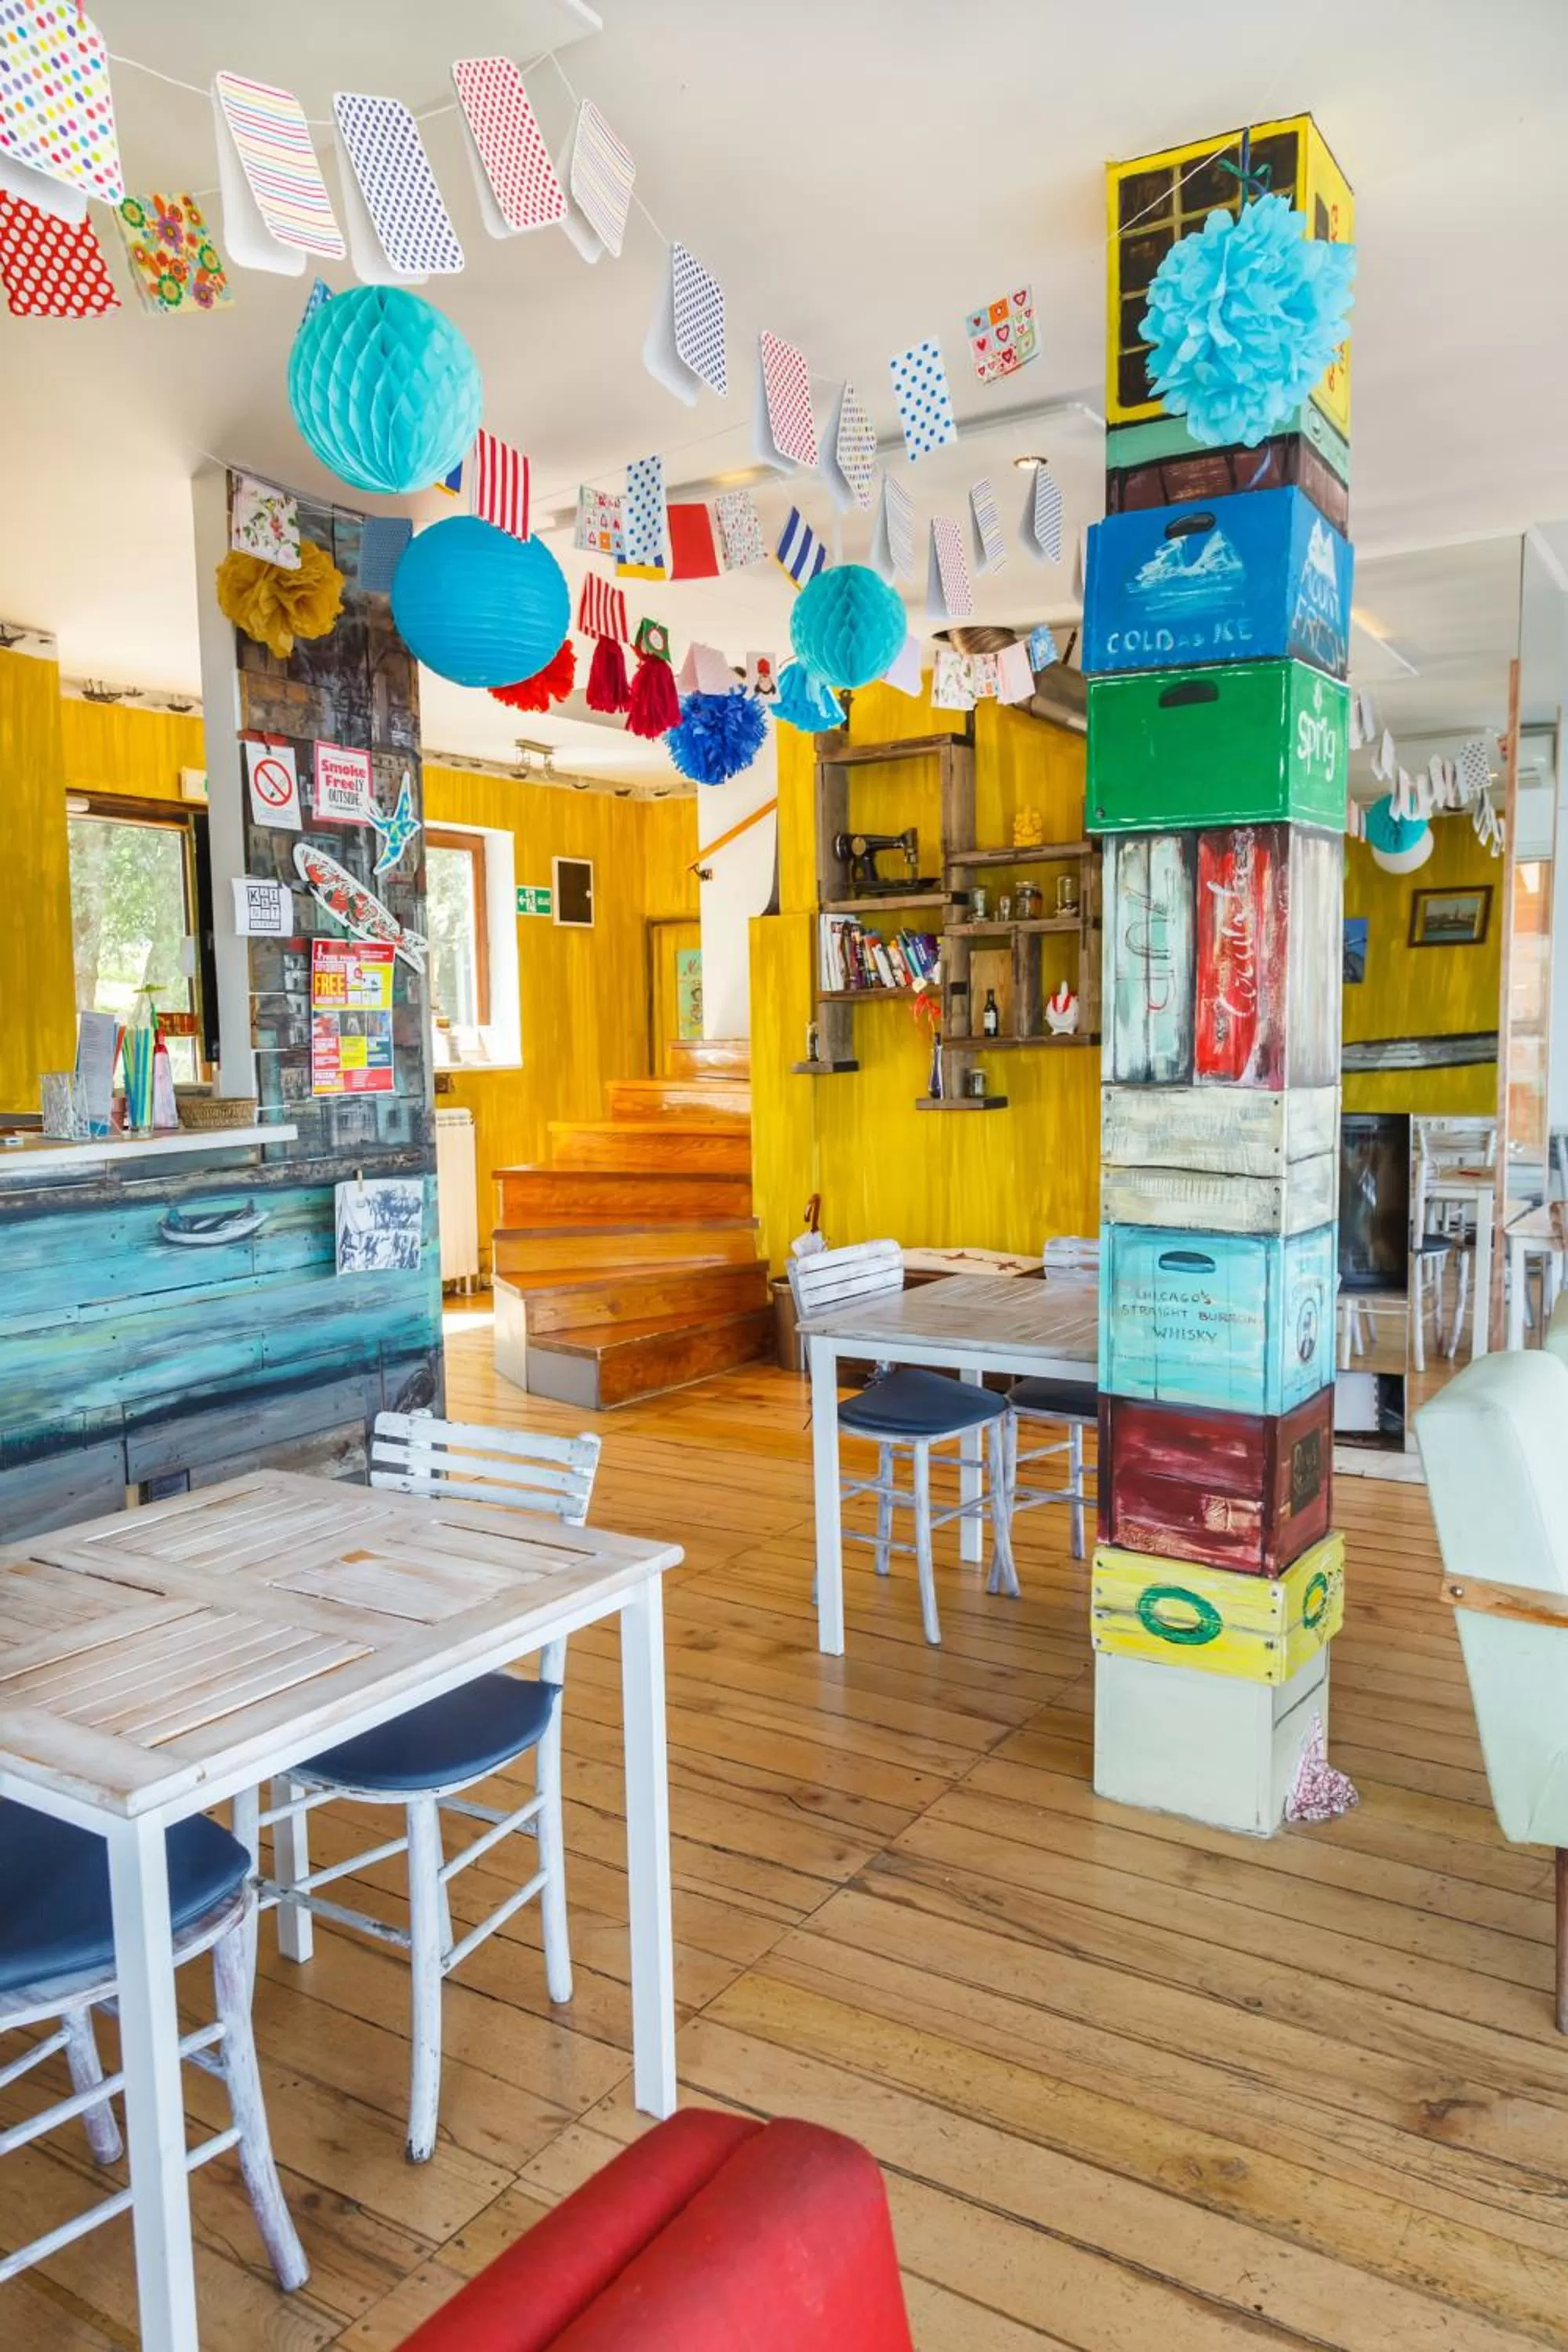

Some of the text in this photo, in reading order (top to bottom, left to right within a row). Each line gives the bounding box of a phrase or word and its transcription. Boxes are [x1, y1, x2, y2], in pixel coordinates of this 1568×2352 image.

[1107, 628, 1174, 654] COLD
[321, 758, 366, 779] Smoke
[315, 973, 345, 996] FREE
[1152, 1326, 1218, 1344] WHISKY
